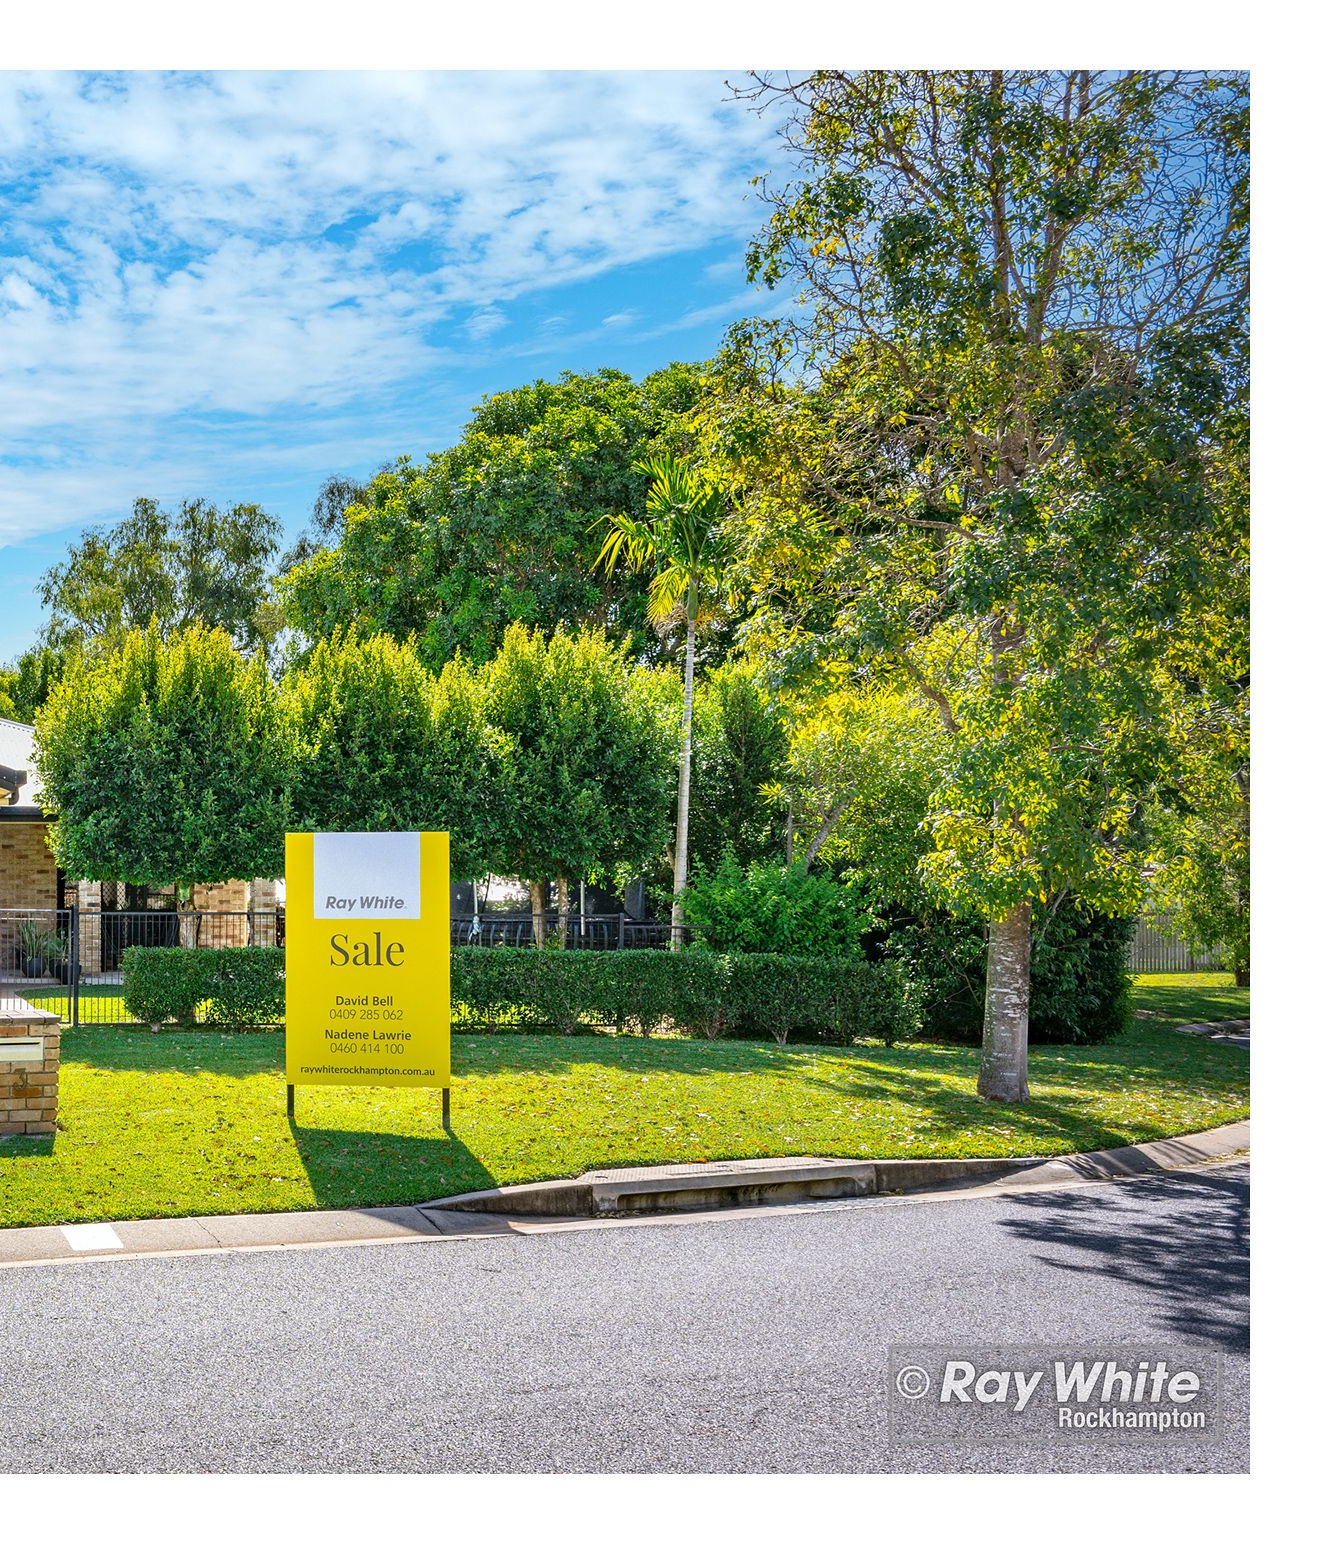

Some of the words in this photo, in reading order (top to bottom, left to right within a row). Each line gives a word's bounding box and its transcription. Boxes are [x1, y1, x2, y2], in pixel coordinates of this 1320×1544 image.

[326, 895, 357, 911] Ray
[360, 895, 405, 909] White
[330, 931, 405, 967] Sale
[335, 995, 369, 1006] David
[372, 996, 393, 1006] Bell
[329, 1009, 357, 1020] 0409
[359, 1009, 380, 1020] 285
[382, 1009, 404, 1021] 062
[324, 1029, 370, 1040] Nadene
[372, 1030, 412, 1041] Lawrie
[329, 1042, 358, 1054] 0460
[359, 1043, 380, 1054] 414
[385, 1043, 405, 1055] 100
[300, 1064, 436, 1076] raywhiterockhampton.com.au
